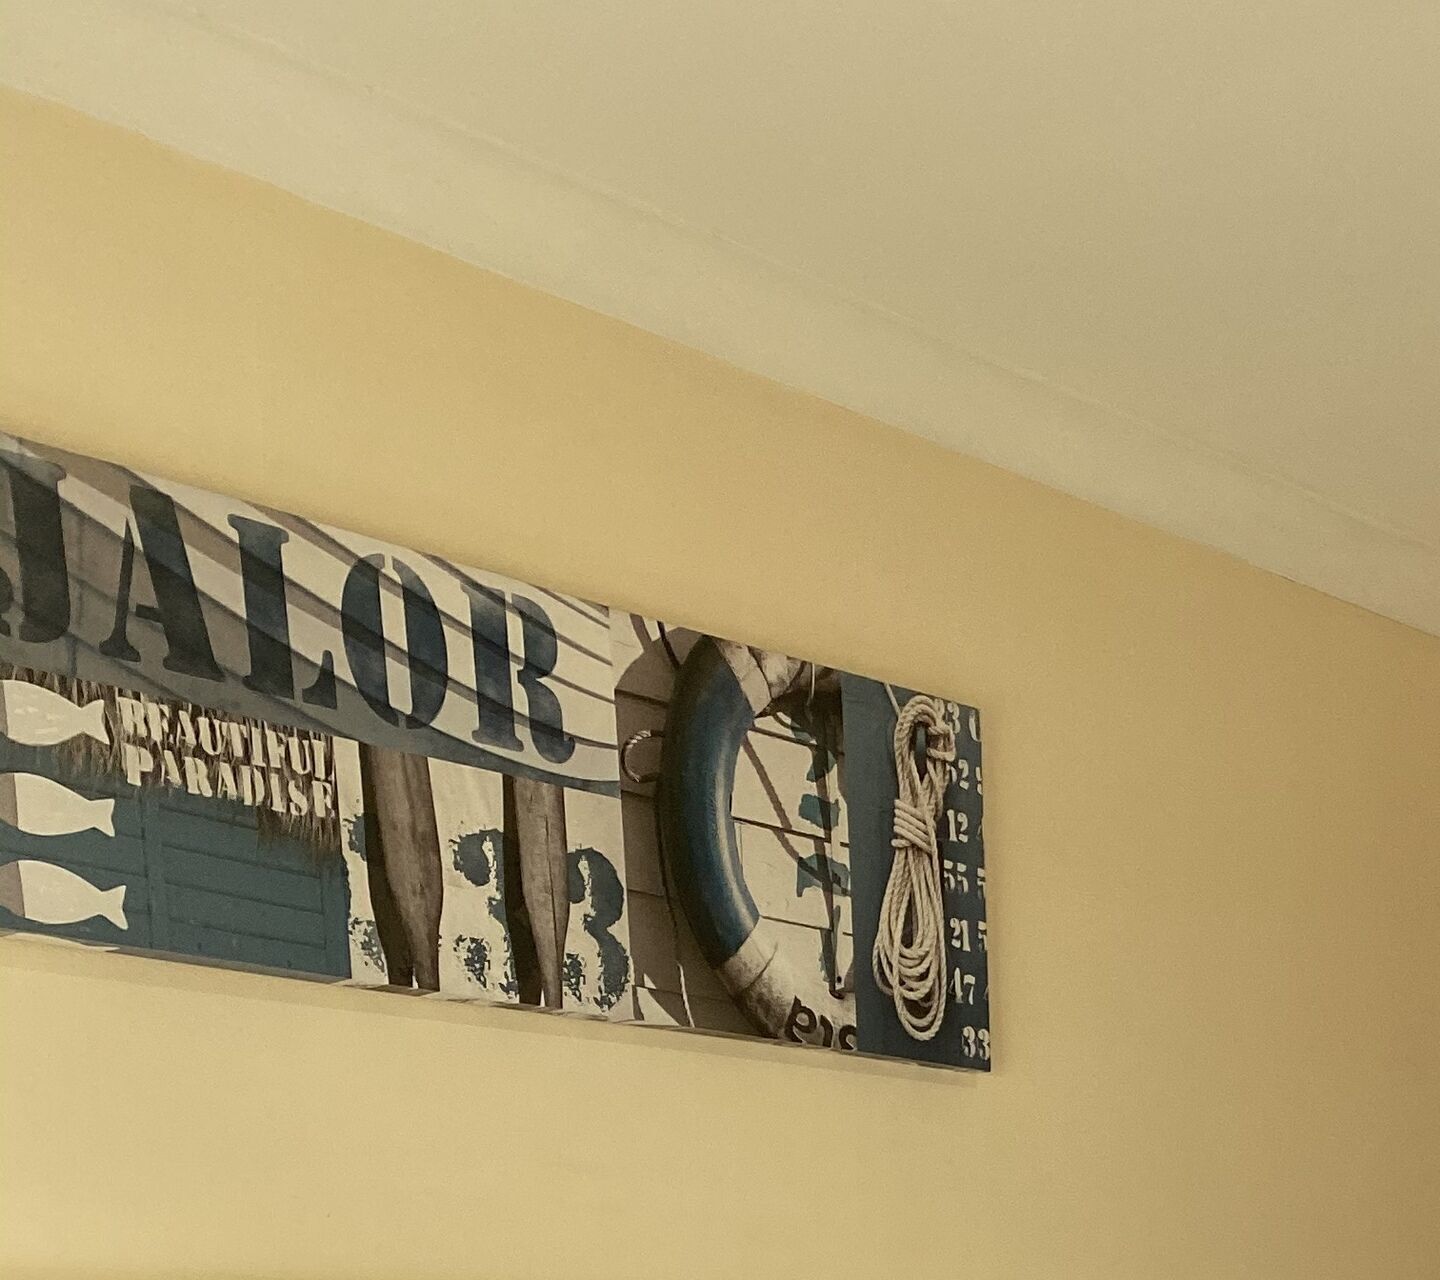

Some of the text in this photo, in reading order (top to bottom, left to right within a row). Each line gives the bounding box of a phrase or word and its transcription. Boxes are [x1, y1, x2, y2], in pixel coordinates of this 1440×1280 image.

[115, 697, 333, 780] BEAUTIFUL
[121, 742, 335, 818] PARADISE
[946, 809, 969, 843] 12
[949, 917, 971, 952] 21
[962, 1025, 990, 1061] 33
